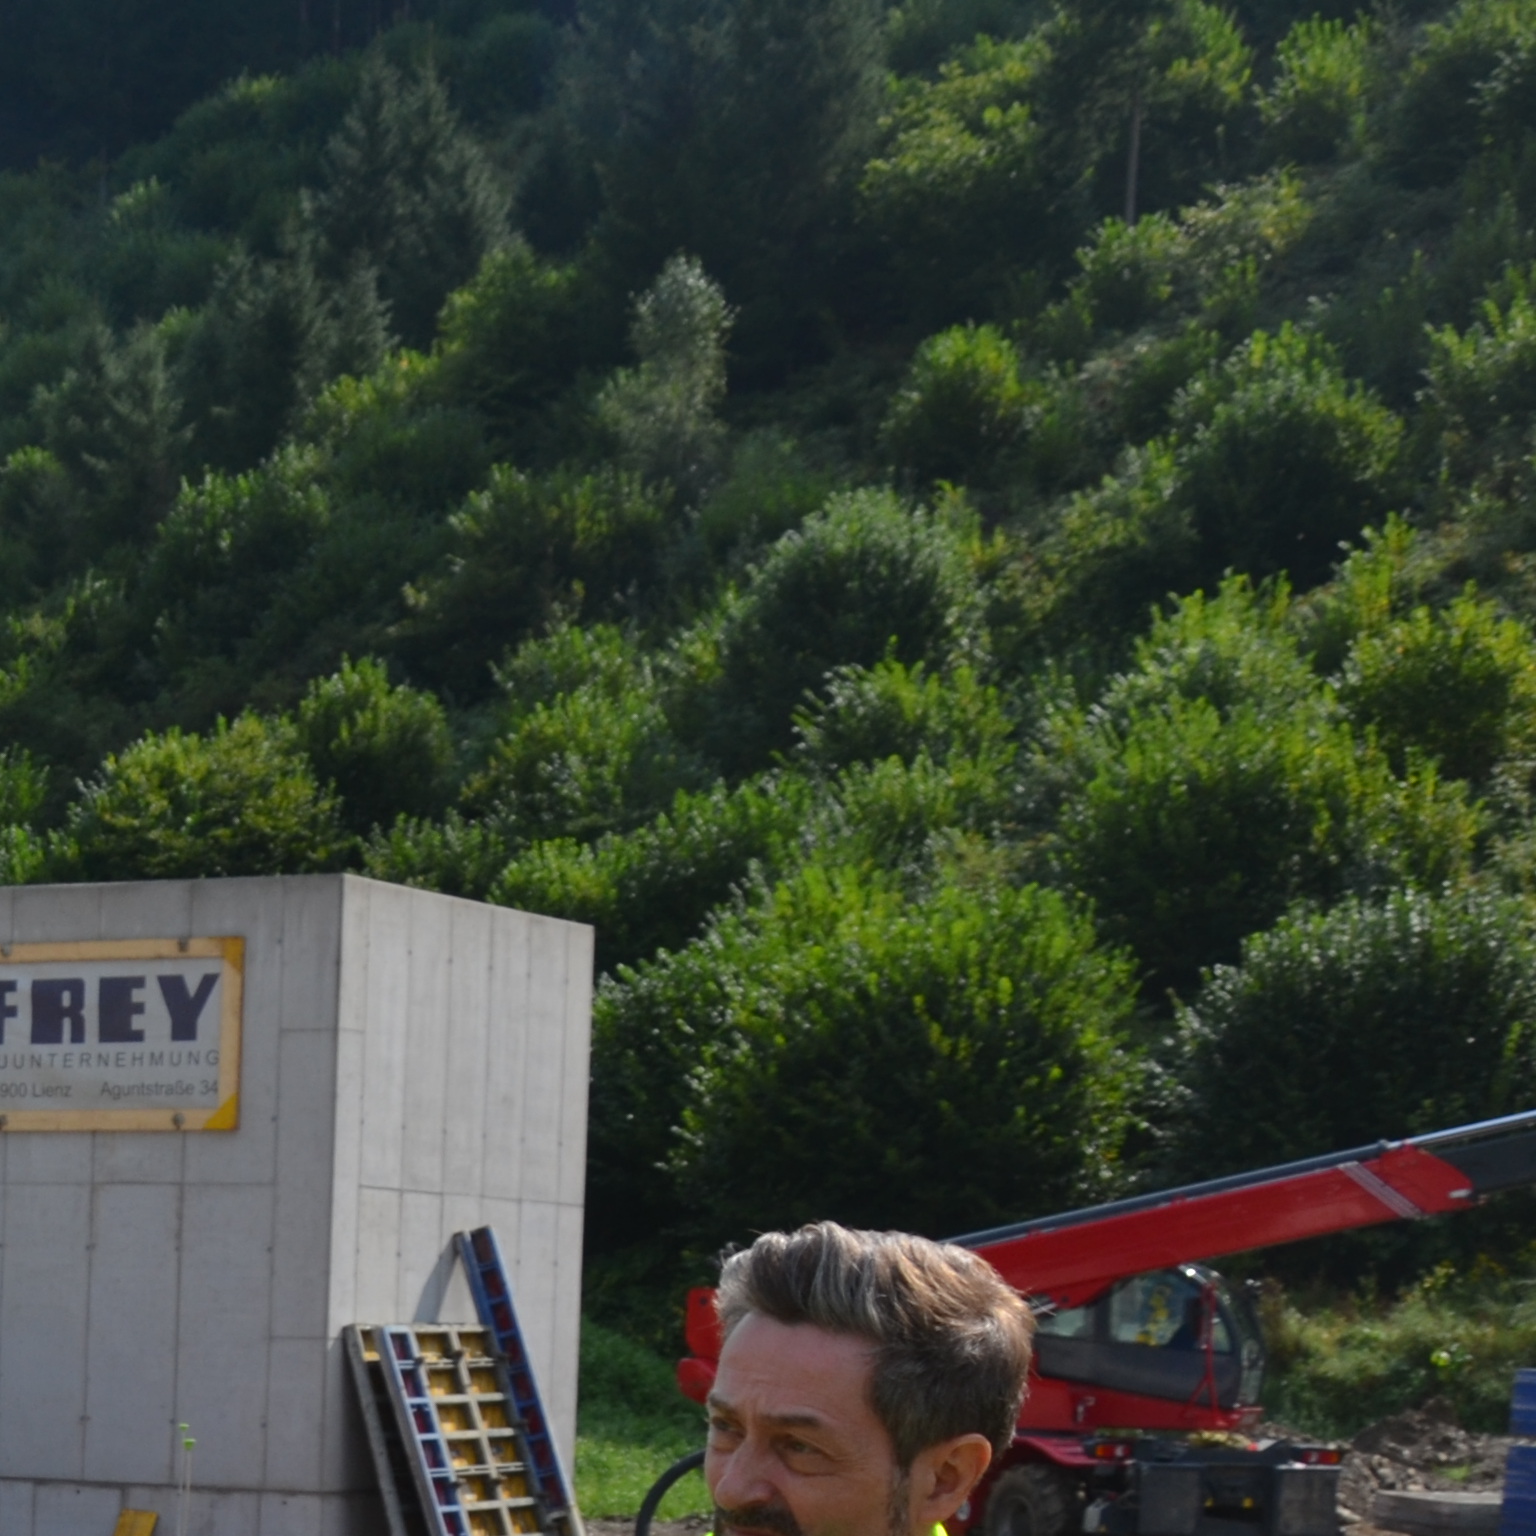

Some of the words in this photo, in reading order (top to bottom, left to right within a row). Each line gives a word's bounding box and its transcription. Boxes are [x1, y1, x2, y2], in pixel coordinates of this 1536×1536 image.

[32, 1081, 73, 1098] Lienz
[100, 1079, 195, 1101] Aguntstraße
[199, 1079, 220, 1096] 34
